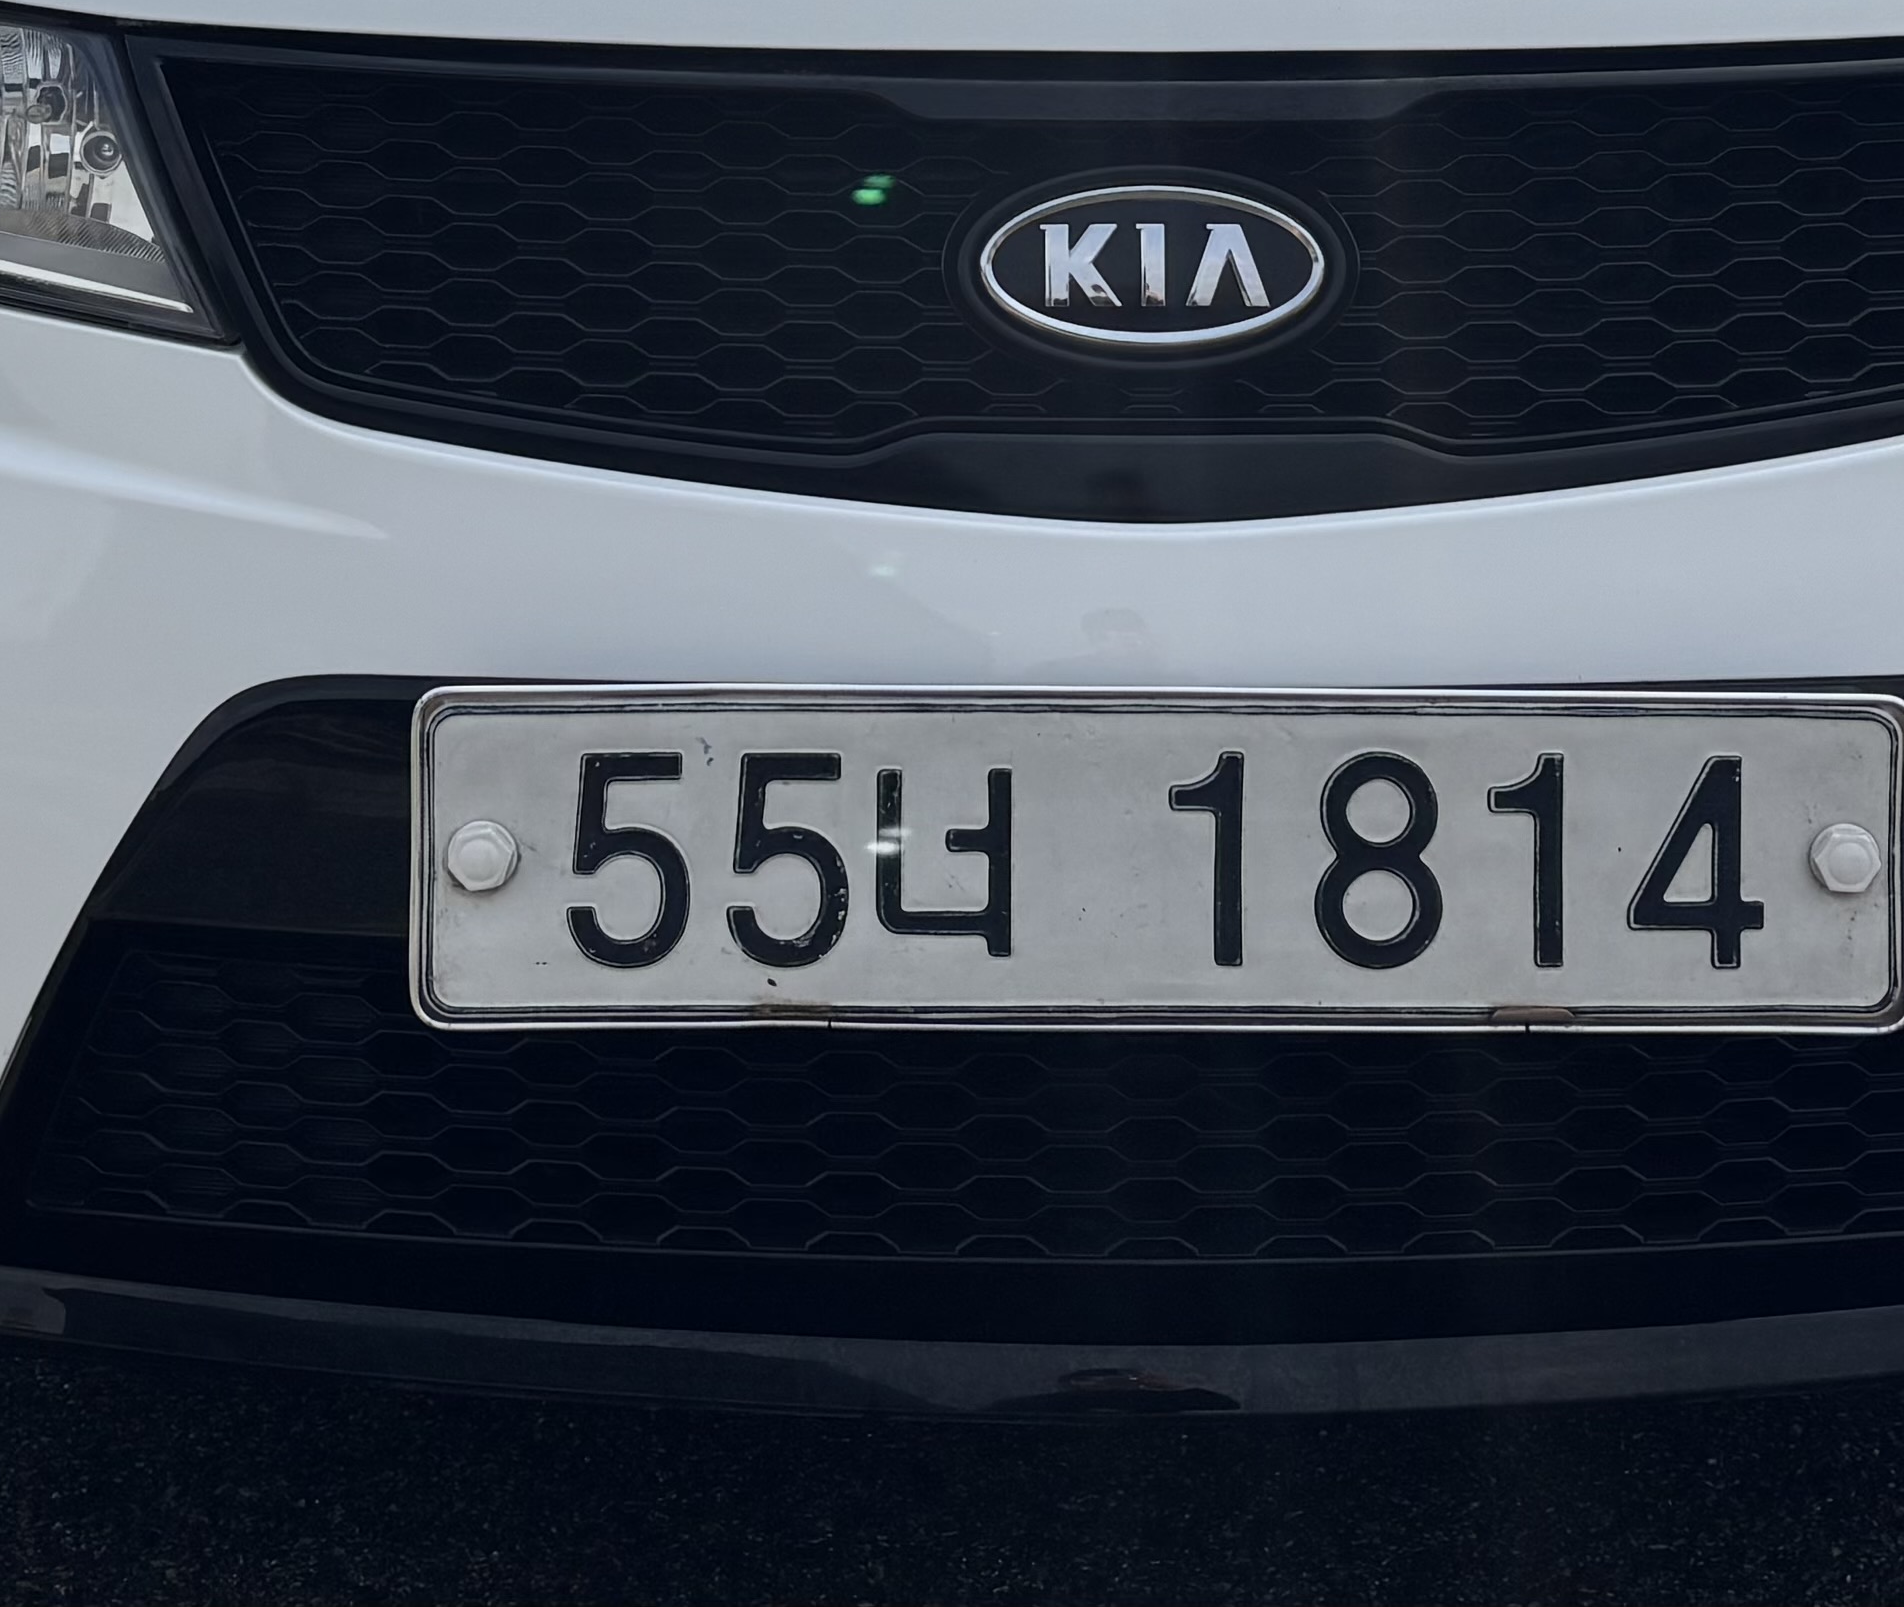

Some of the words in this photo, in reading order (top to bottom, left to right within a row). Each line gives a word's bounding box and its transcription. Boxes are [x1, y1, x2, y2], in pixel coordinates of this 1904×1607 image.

[1039, 223, 1271, 308] KIA
[565, 750, 1013, 967] 55너
[1167, 750, 1766, 970] 1814
